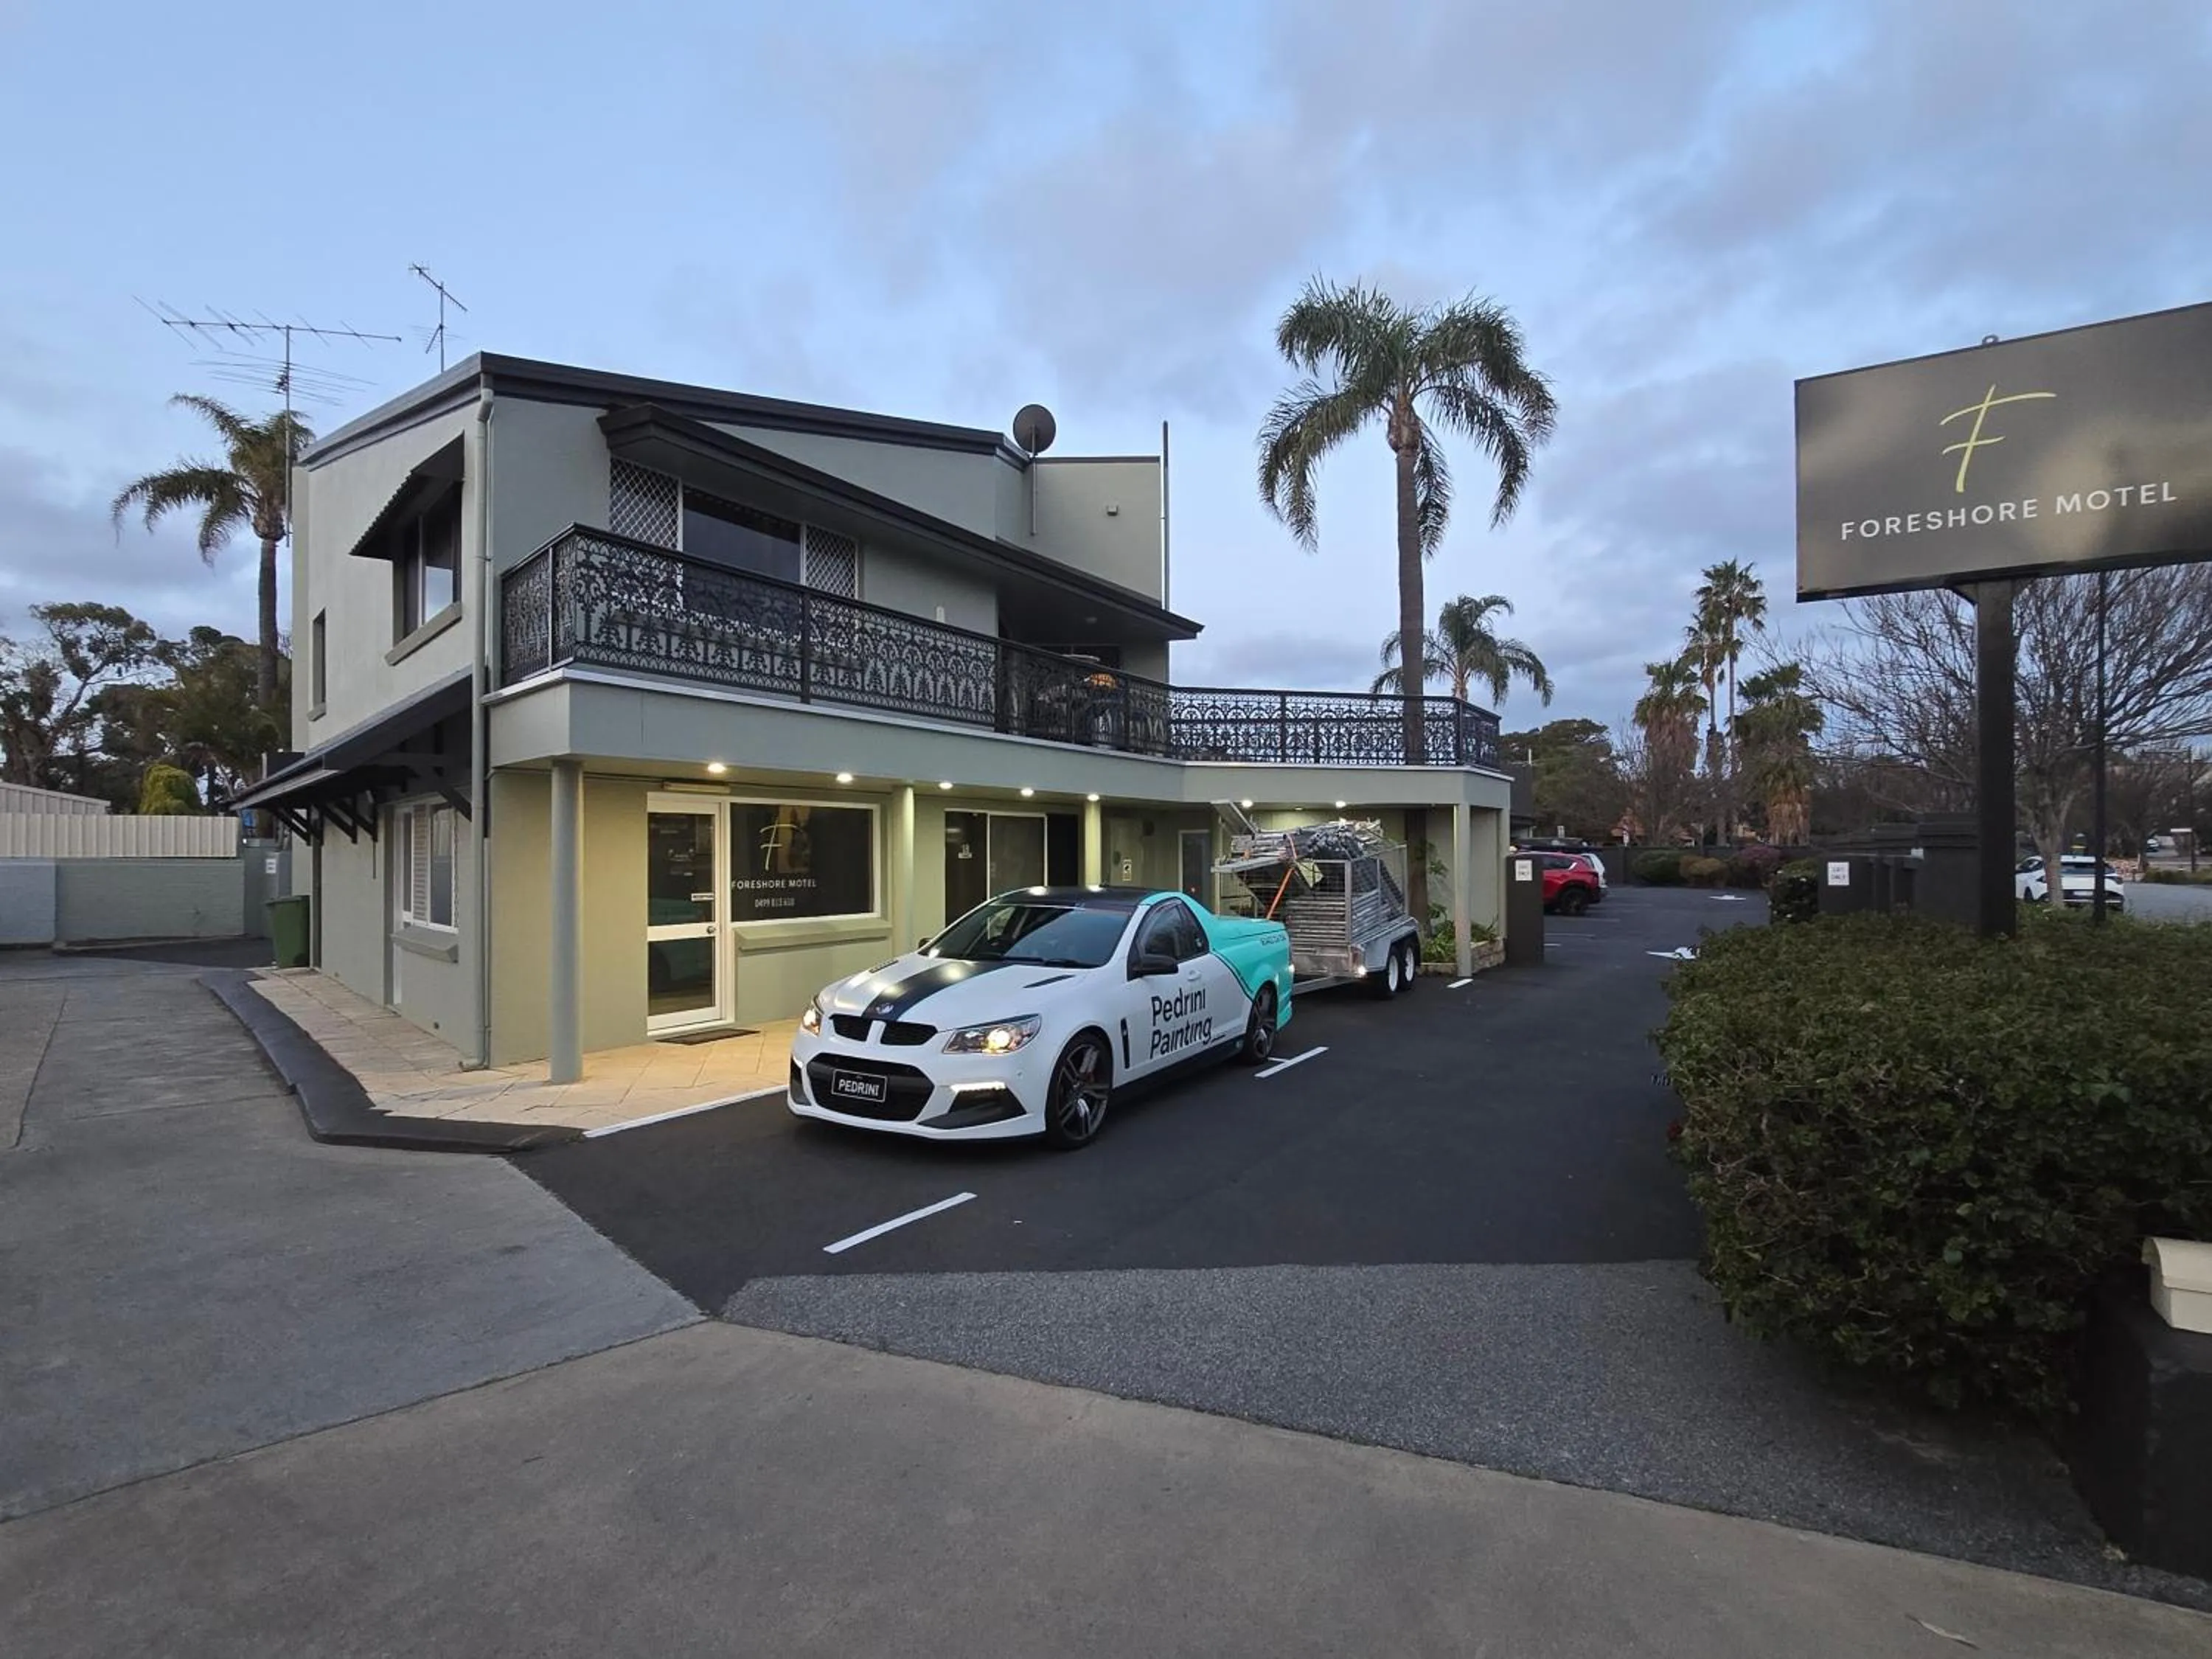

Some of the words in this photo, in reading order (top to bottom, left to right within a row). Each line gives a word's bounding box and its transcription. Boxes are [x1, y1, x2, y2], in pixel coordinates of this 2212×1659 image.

[1840, 498, 2038, 540] FORESHORE
[2056, 481, 2177, 515] MOTEL
[731, 879, 787, 890] FORESHORE
[788, 878, 817, 888] MOTEL
[1150, 987, 1206, 1026] Pedrini
[1150, 1016, 1213, 1060] Painting
[838, 1079, 880, 1096] PEDRINI
